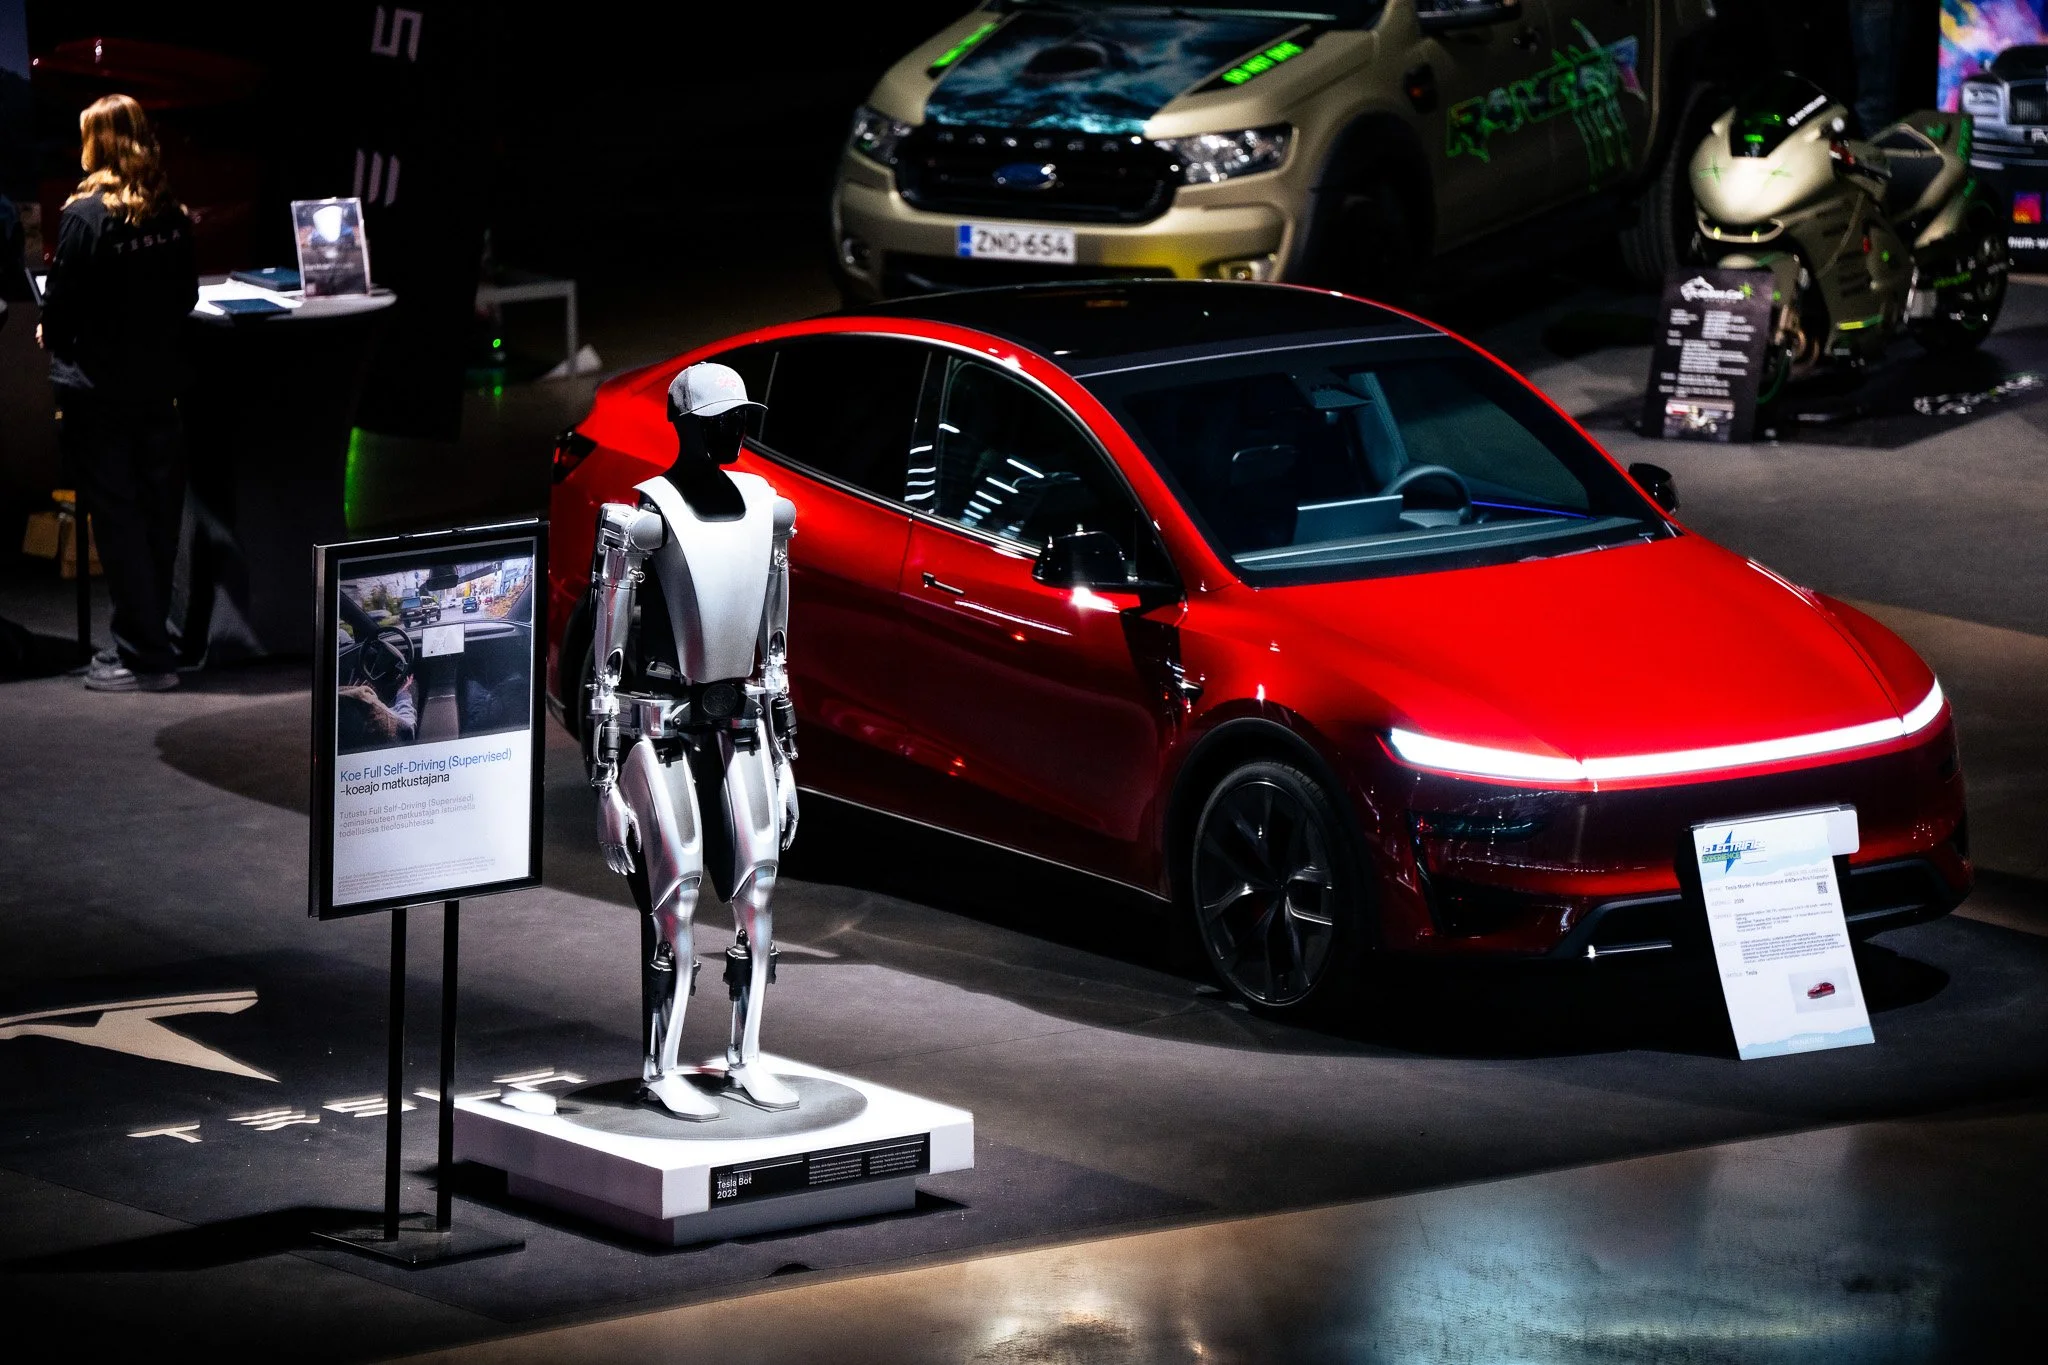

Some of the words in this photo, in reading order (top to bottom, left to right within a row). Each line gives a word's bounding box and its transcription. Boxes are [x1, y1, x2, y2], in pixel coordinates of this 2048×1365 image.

[340, 770, 362, 782] Koe
[363, 766, 382, 779] Full
[383, 758, 446, 777] Self-Driving
[448, 749, 512, 769] (Supervised)
[381, 772, 450, 790] matkustajana
[339, 808, 368, 820] Tutustu
[369, 806, 382, 816] Full
[383, 800, 427, 814] Self-Driving
[428, 794, 474, 808] (Supervised)
[396, 808, 440, 821] matkustajan
[717, 1179, 737, 1189] Tesla
[738, 1176, 752, 1186] Bot
[717, 1188, 737, 1199] 2023
